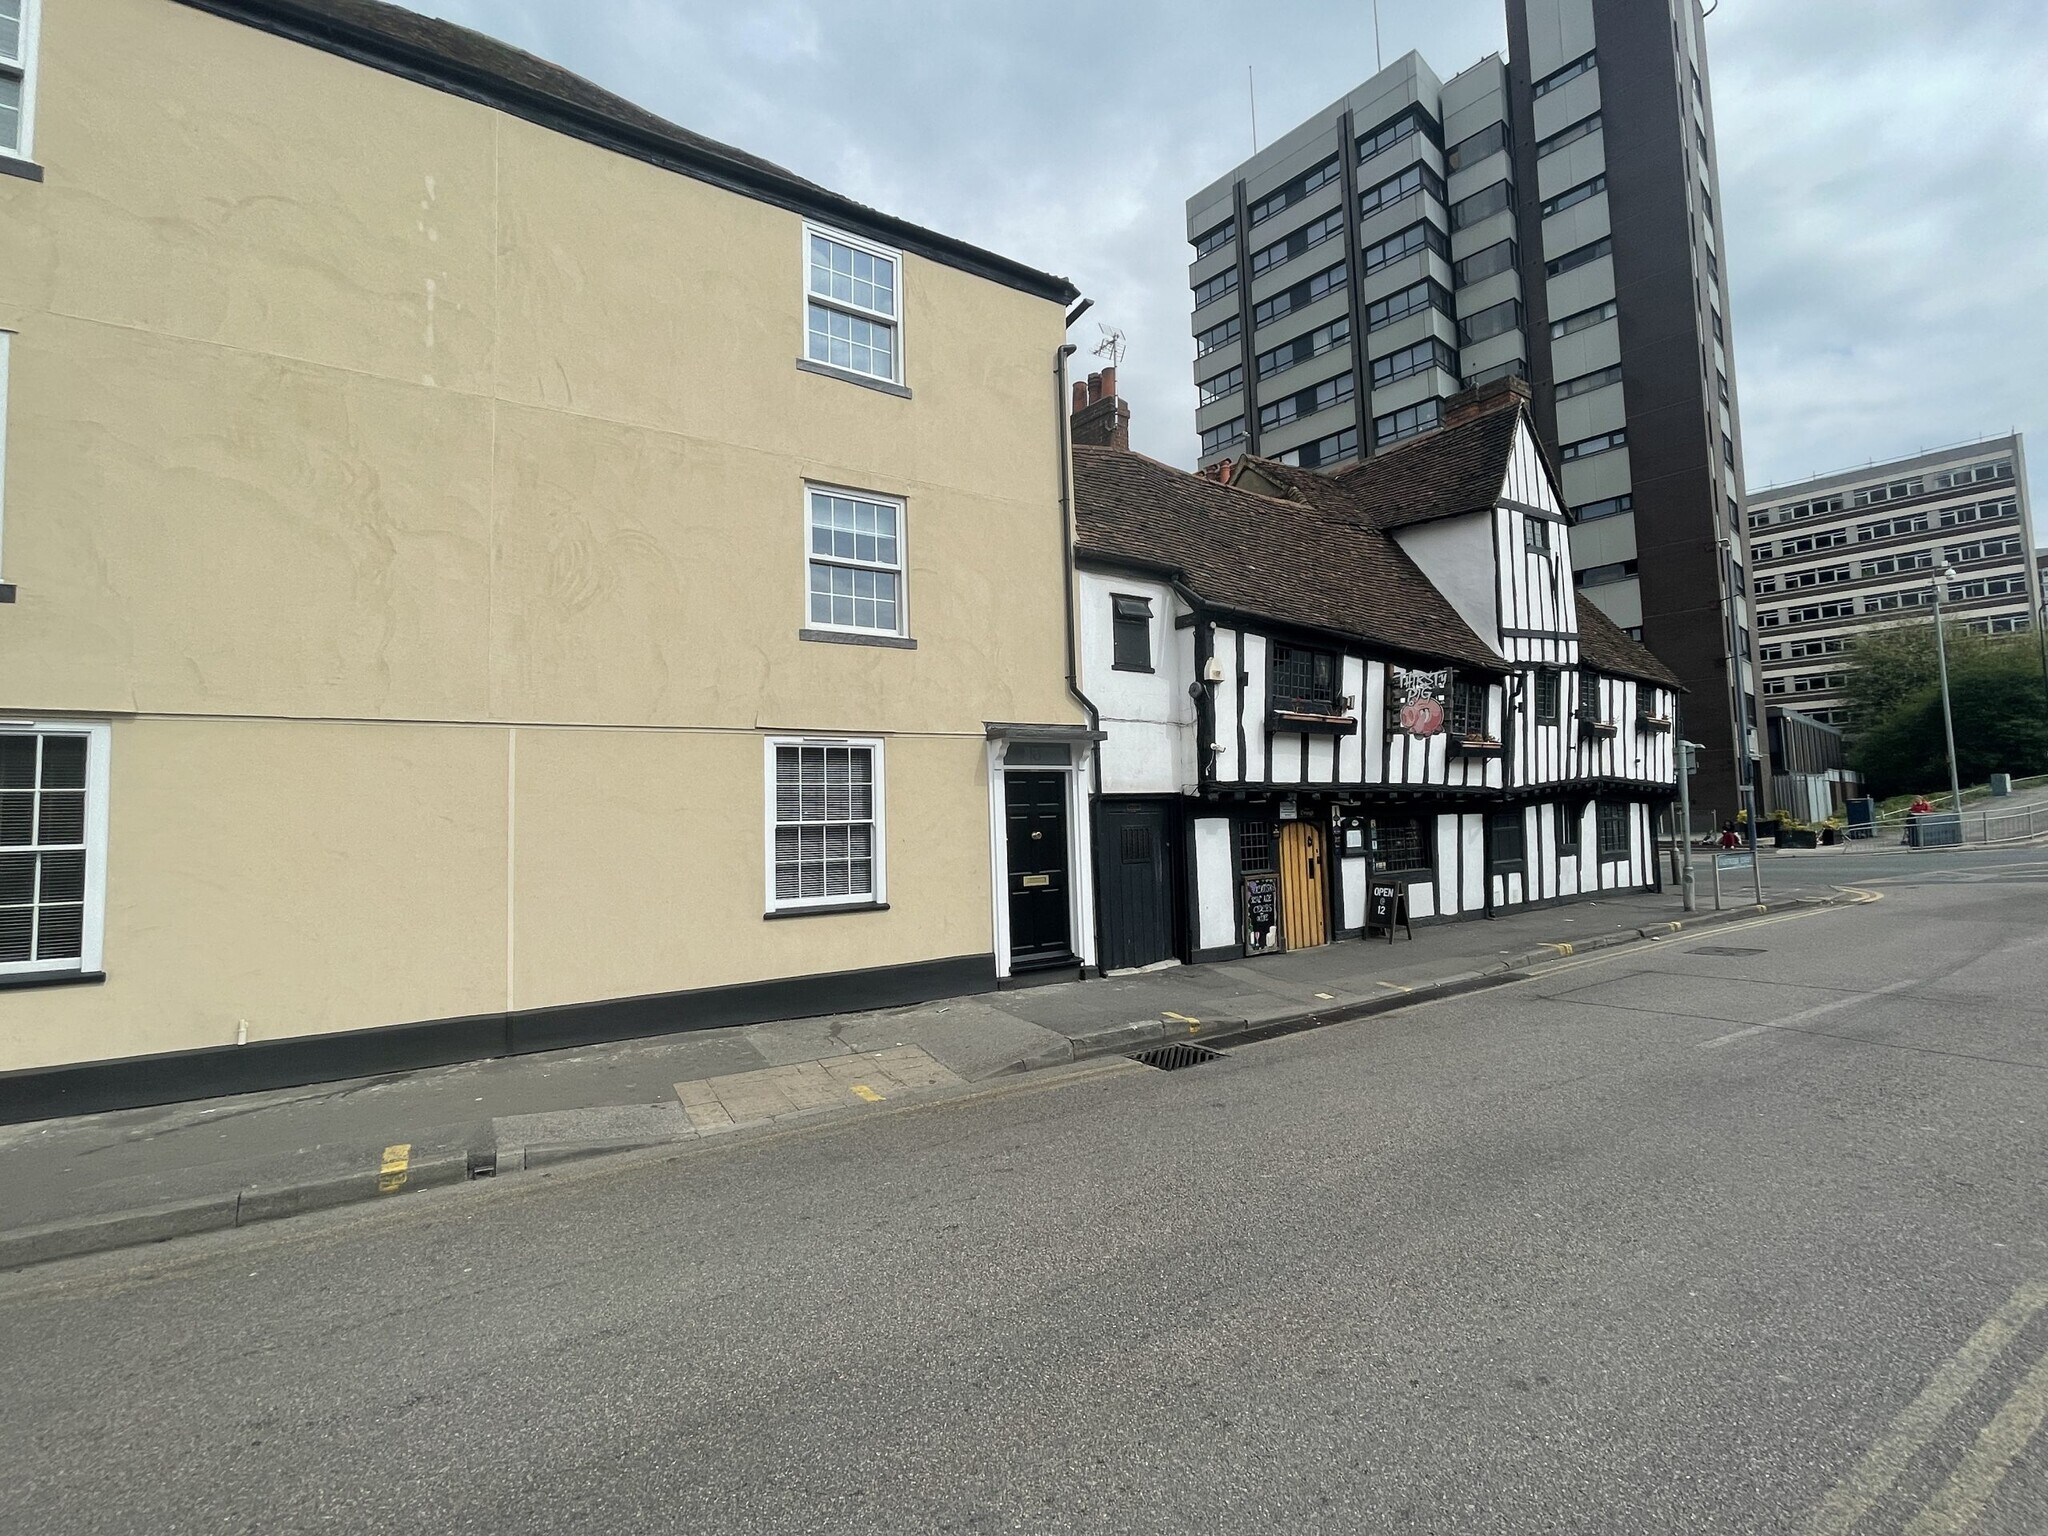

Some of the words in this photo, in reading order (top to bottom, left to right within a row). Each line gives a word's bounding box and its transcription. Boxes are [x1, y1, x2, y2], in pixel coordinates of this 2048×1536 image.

[1393, 670, 1447, 690] THIRSTY
[1406, 687, 1432, 703] PIG
[1374, 887, 1394, 898] OPEN
[1377, 905, 1386, 915] 12
